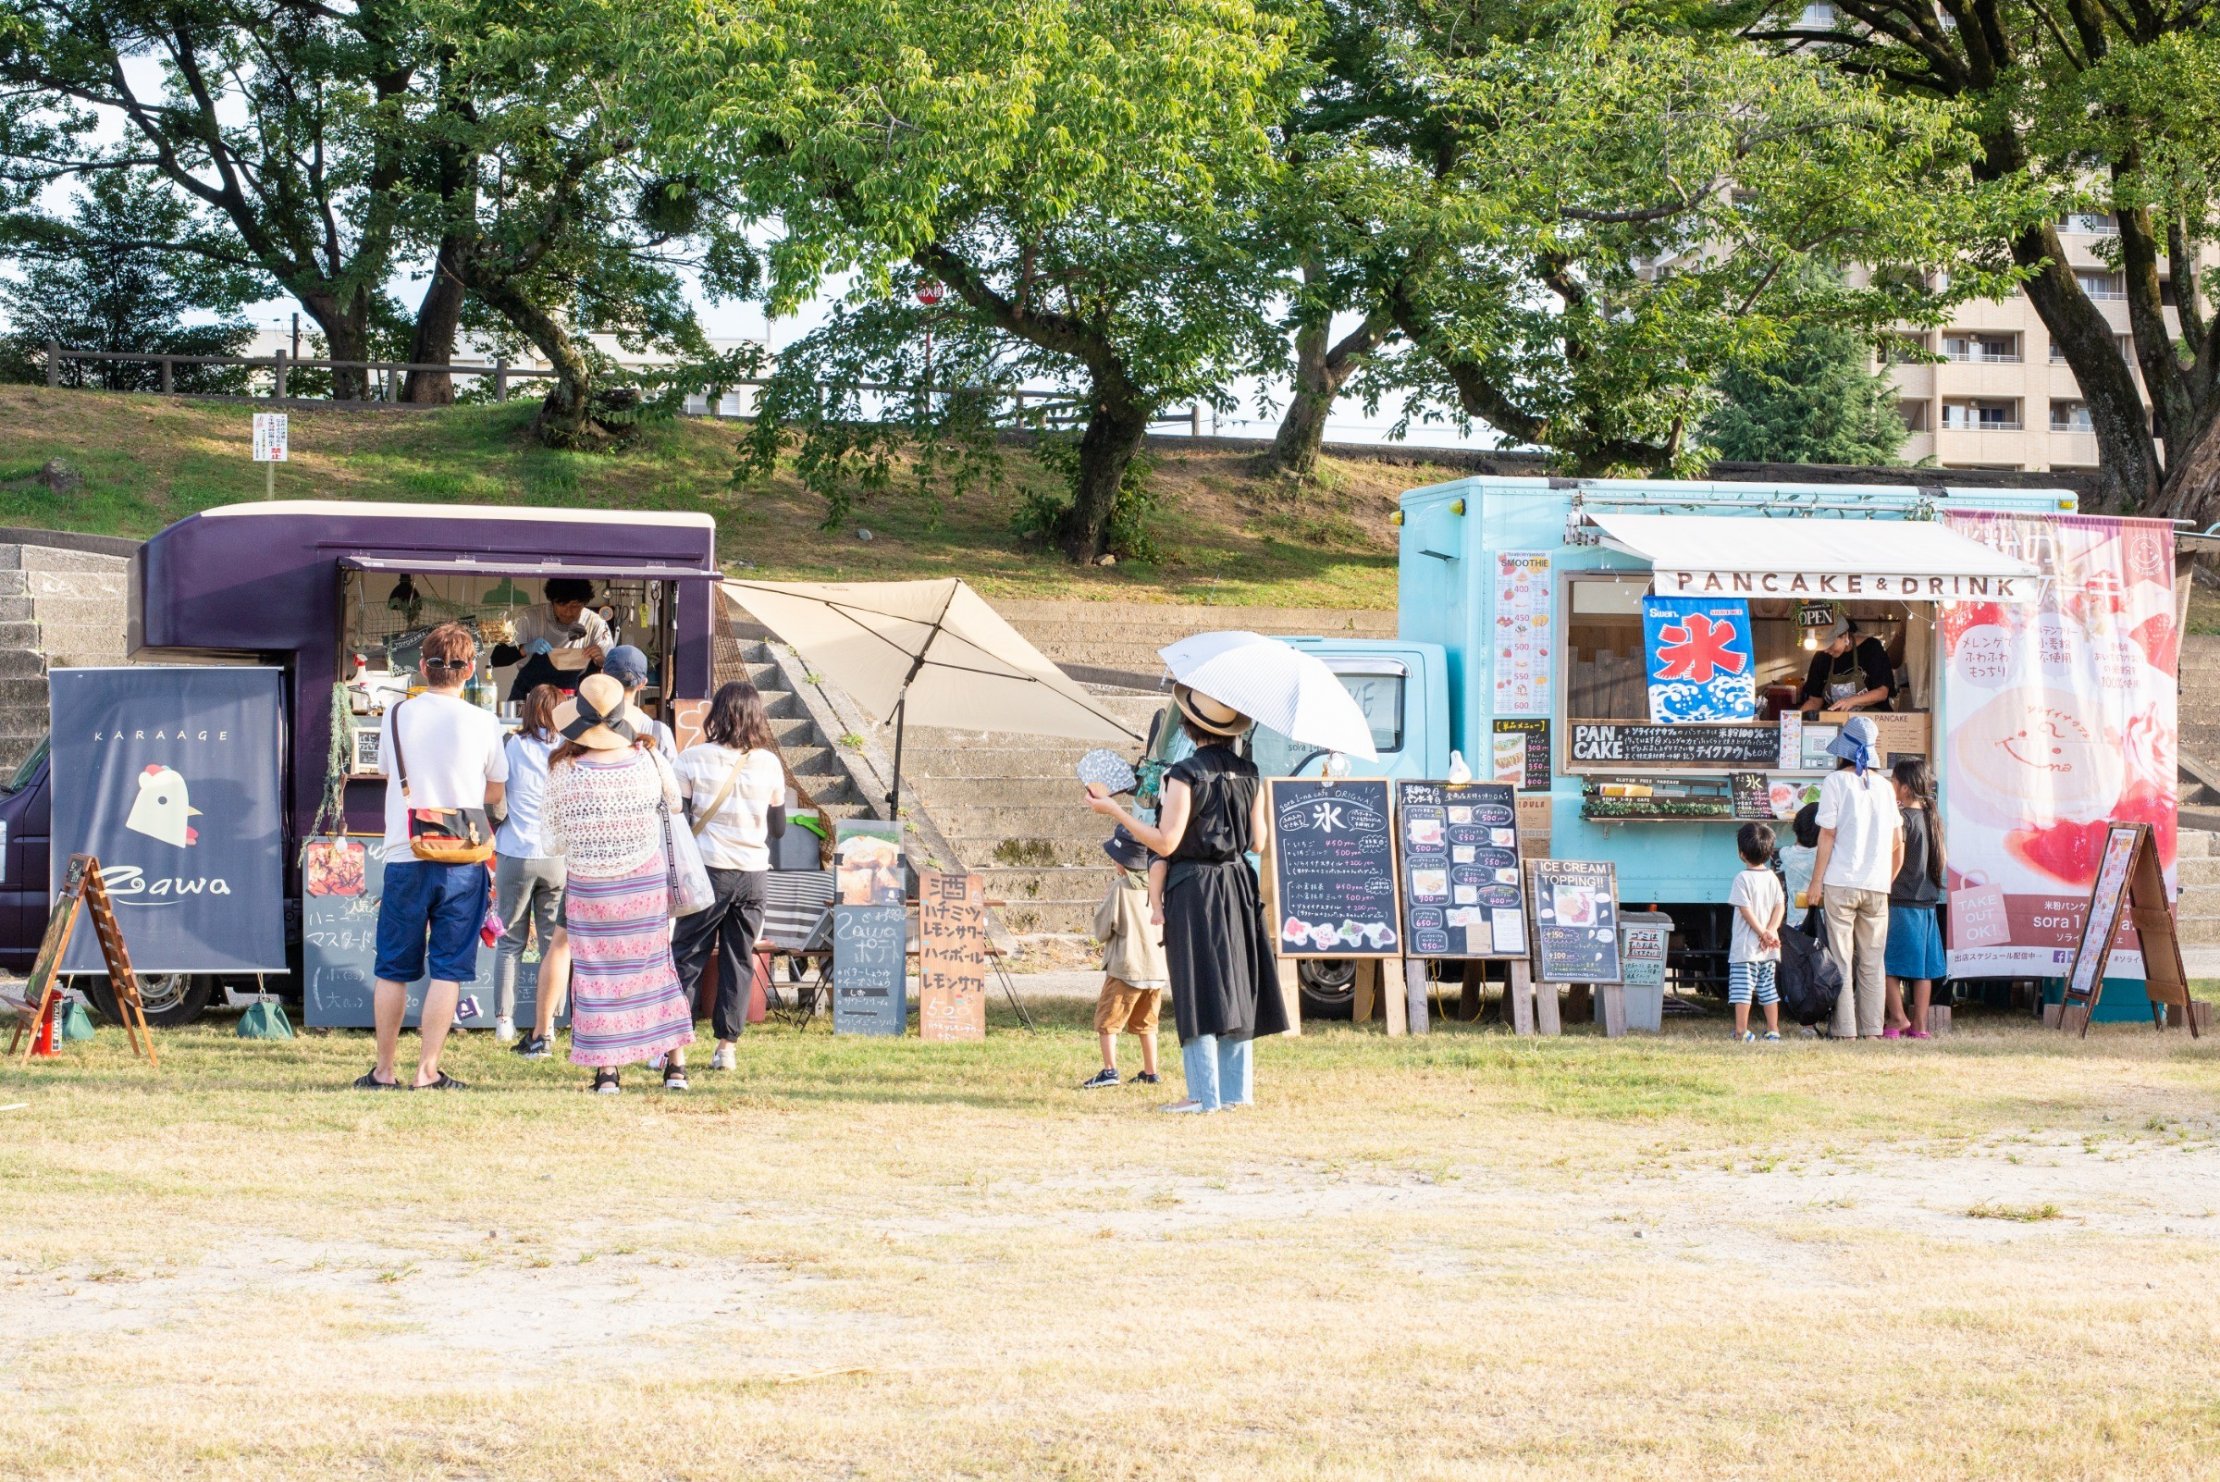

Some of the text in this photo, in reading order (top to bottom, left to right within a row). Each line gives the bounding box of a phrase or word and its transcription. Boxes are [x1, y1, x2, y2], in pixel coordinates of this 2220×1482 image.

[1501, 559, 1549, 568] SMOOTHIE
[1514, 585, 1529, 593] 400
[1514, 614, 1530, 622] 450
[1798, 609, 1833, 626] OPEN
[1514, 643, 1530, 651] 500
[1653, 612, 1748, 684] 氷
[1965, 652, 2009, 663] ふわふわ
[2039, 652, 2072, 664] 不使用
[1968, 666, 2006, 678] もっちり
[1875, 714, 1909, 723] PANCAKE
[94, 729, 230, 742] KARAAGE
[1573, 741, 1623, 759] CAKE
[1528, 763, 1543, 771] 350
[1312, 802, 1348, 833] 氷
[1481, 814, 1497, 822] 500
[1335, 849, 1351, 857] 500
[1415, 844, 1431, 852] 500
[1484, 858, 1500, 866] 550
[1540, 862, 1607, 874] ICE CREAM
[98, 865, 231, 896] Zawa
[929, 873, 968, 900] 酒
[1543, 875, 1604, 888] TOPPING!!
[349, 900, 370, 914] 人気
[1489, 897, 1505, 905] 400
[1959, 894, 1998, 911] TAKE
[925, 901, 981, 922] ハチミツ
[1965, 910, 1994, 924] OUT
[837, 912, 898, 940] Zawa
[1416, 919, 1432, 927] 650
[2033, 915, 2070, 929] sora
[923, 921, 983, 939] レモンサワー
[1631, 931, 1658, 940] ゴミは
[1966, 924, 1998, 941] OK!
[854, 938, 900, 964] ポテト
[925, 944, 985, 965] ハイボール
[922, 972, 985, 993] レモンサワー
[926, 996, 971, 1017] 500
